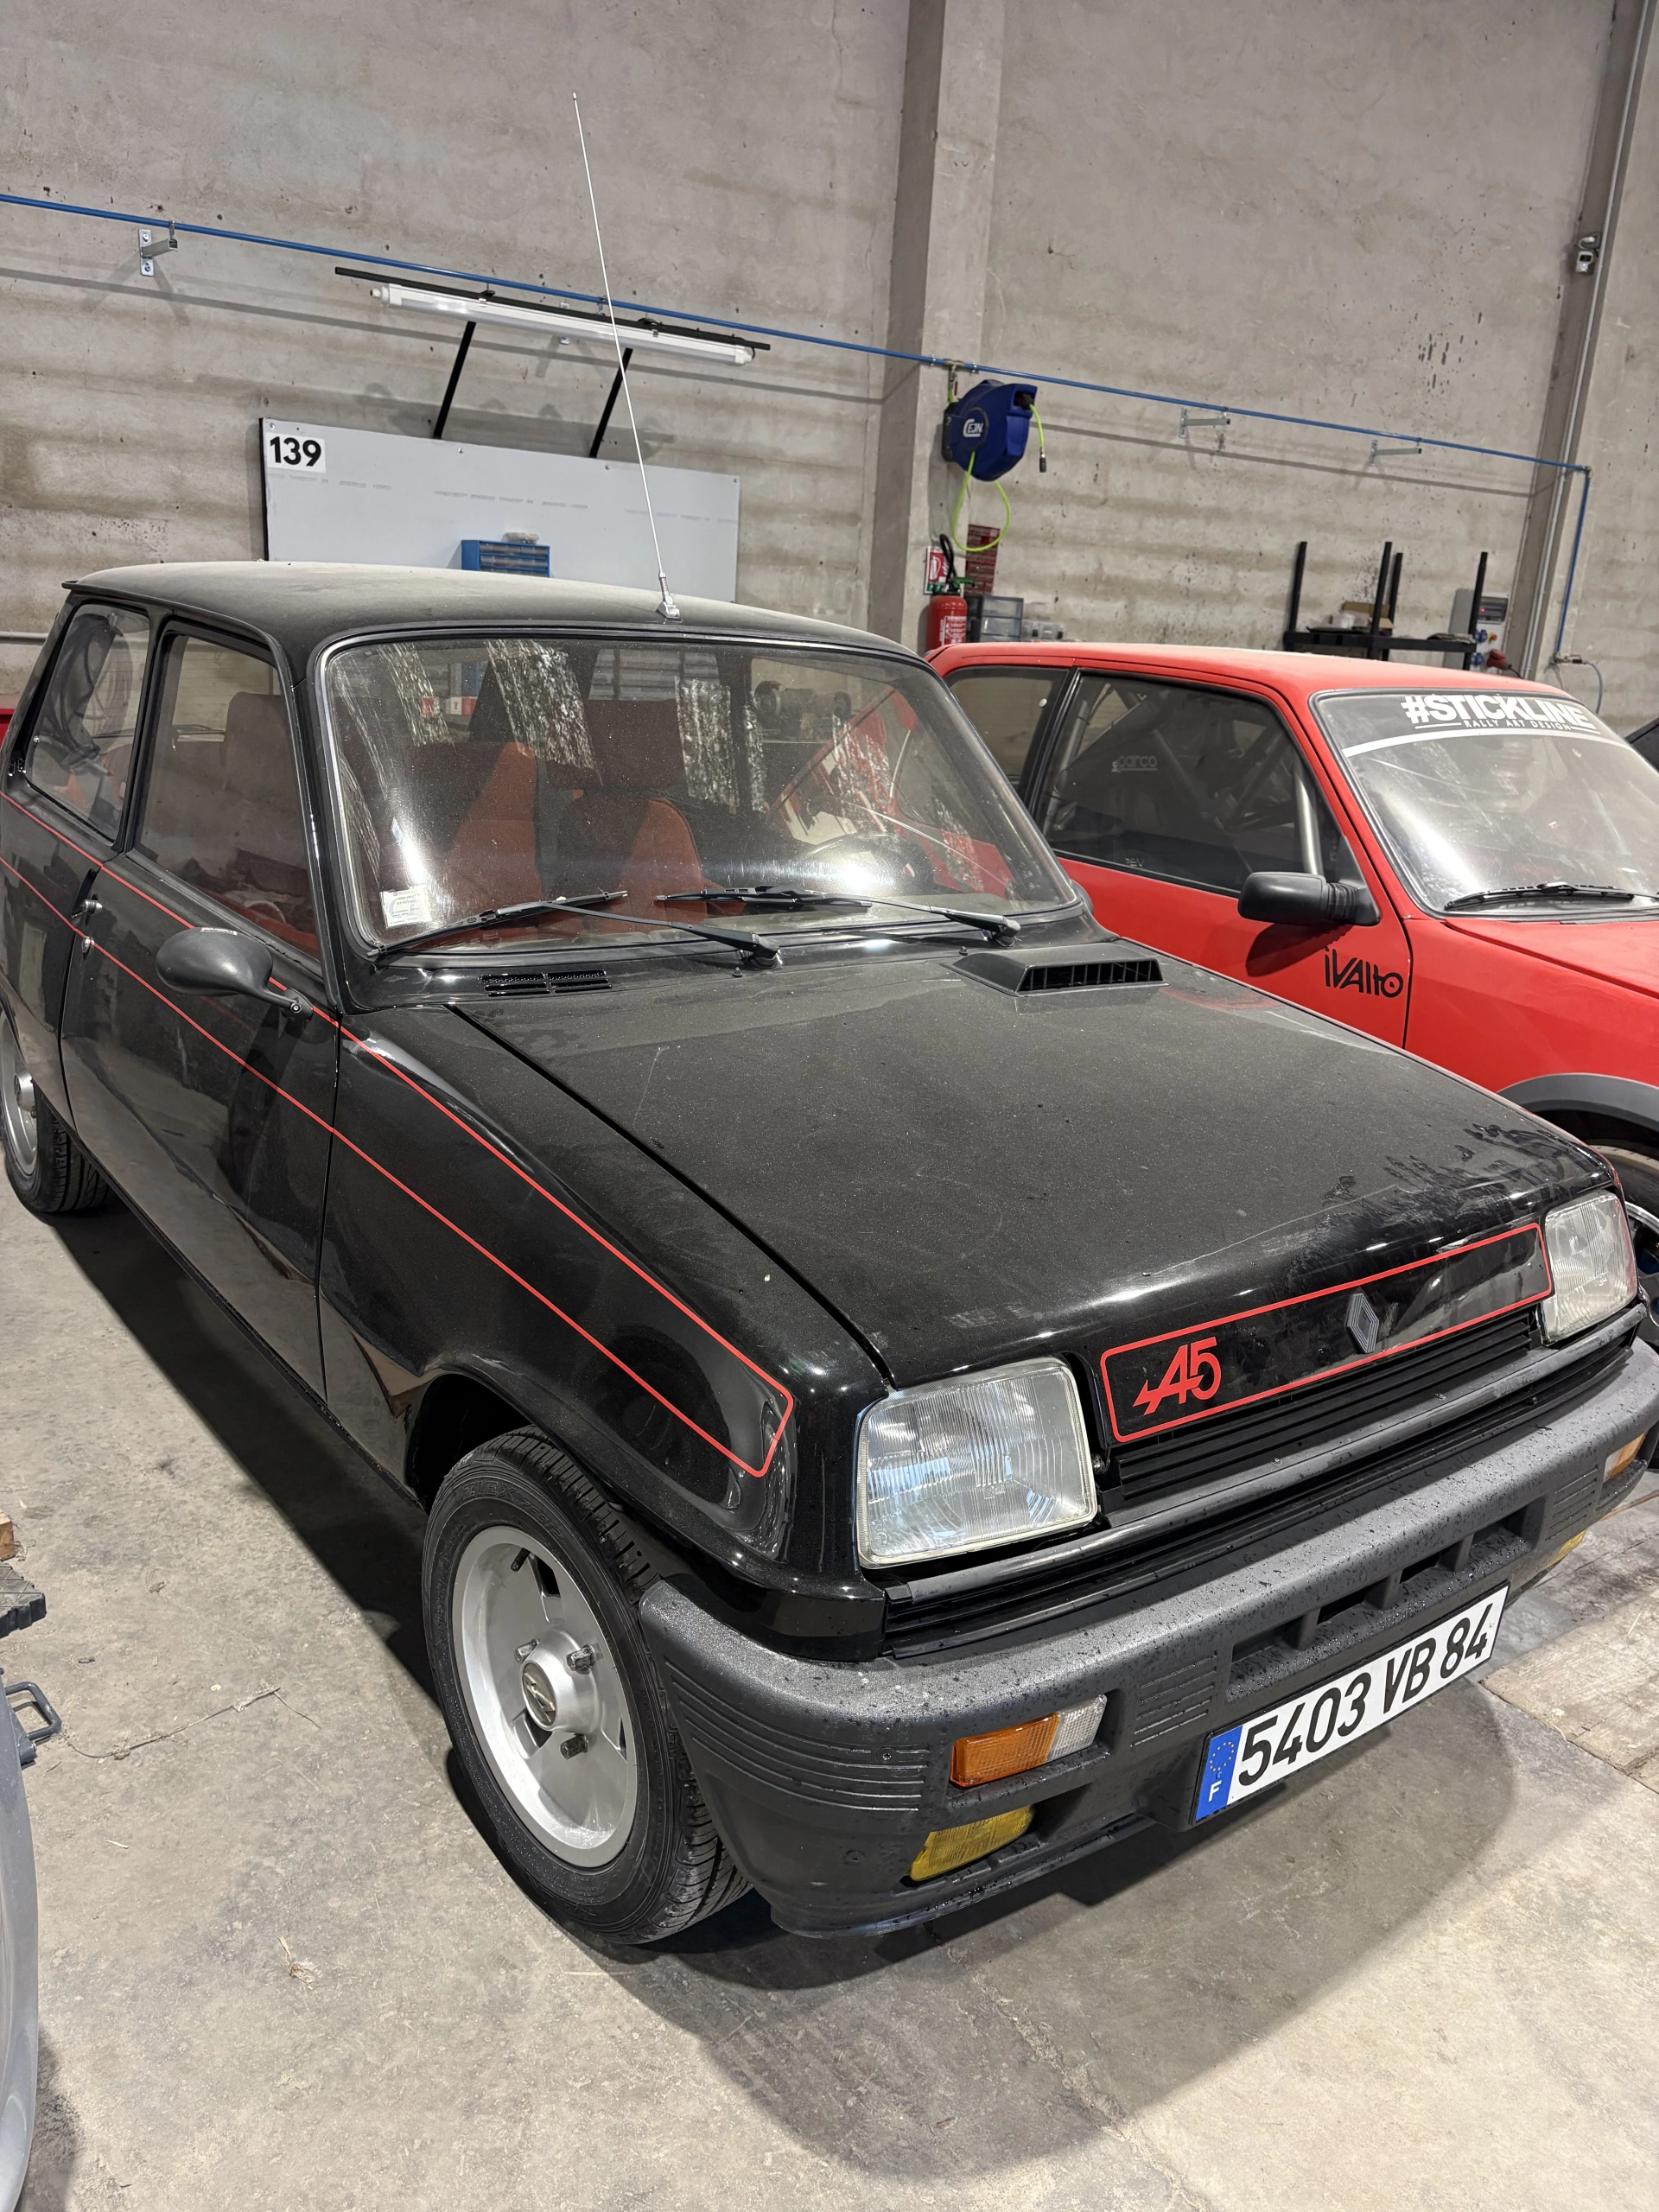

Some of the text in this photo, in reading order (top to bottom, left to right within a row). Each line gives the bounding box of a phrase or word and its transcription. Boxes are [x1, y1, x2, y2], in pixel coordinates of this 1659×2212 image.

[270, 436, 321, 467] 139
[1401, 693, 1597, 730] #STICKLINE
[1465, 719, 1572, 731] RALLY ART DESIGN
[1132, 1336, 1222, 1416] A5
[1238, 1603, 1494, 1787] 5403 VB 84
[1208, 1780, 1222, 1802] F
